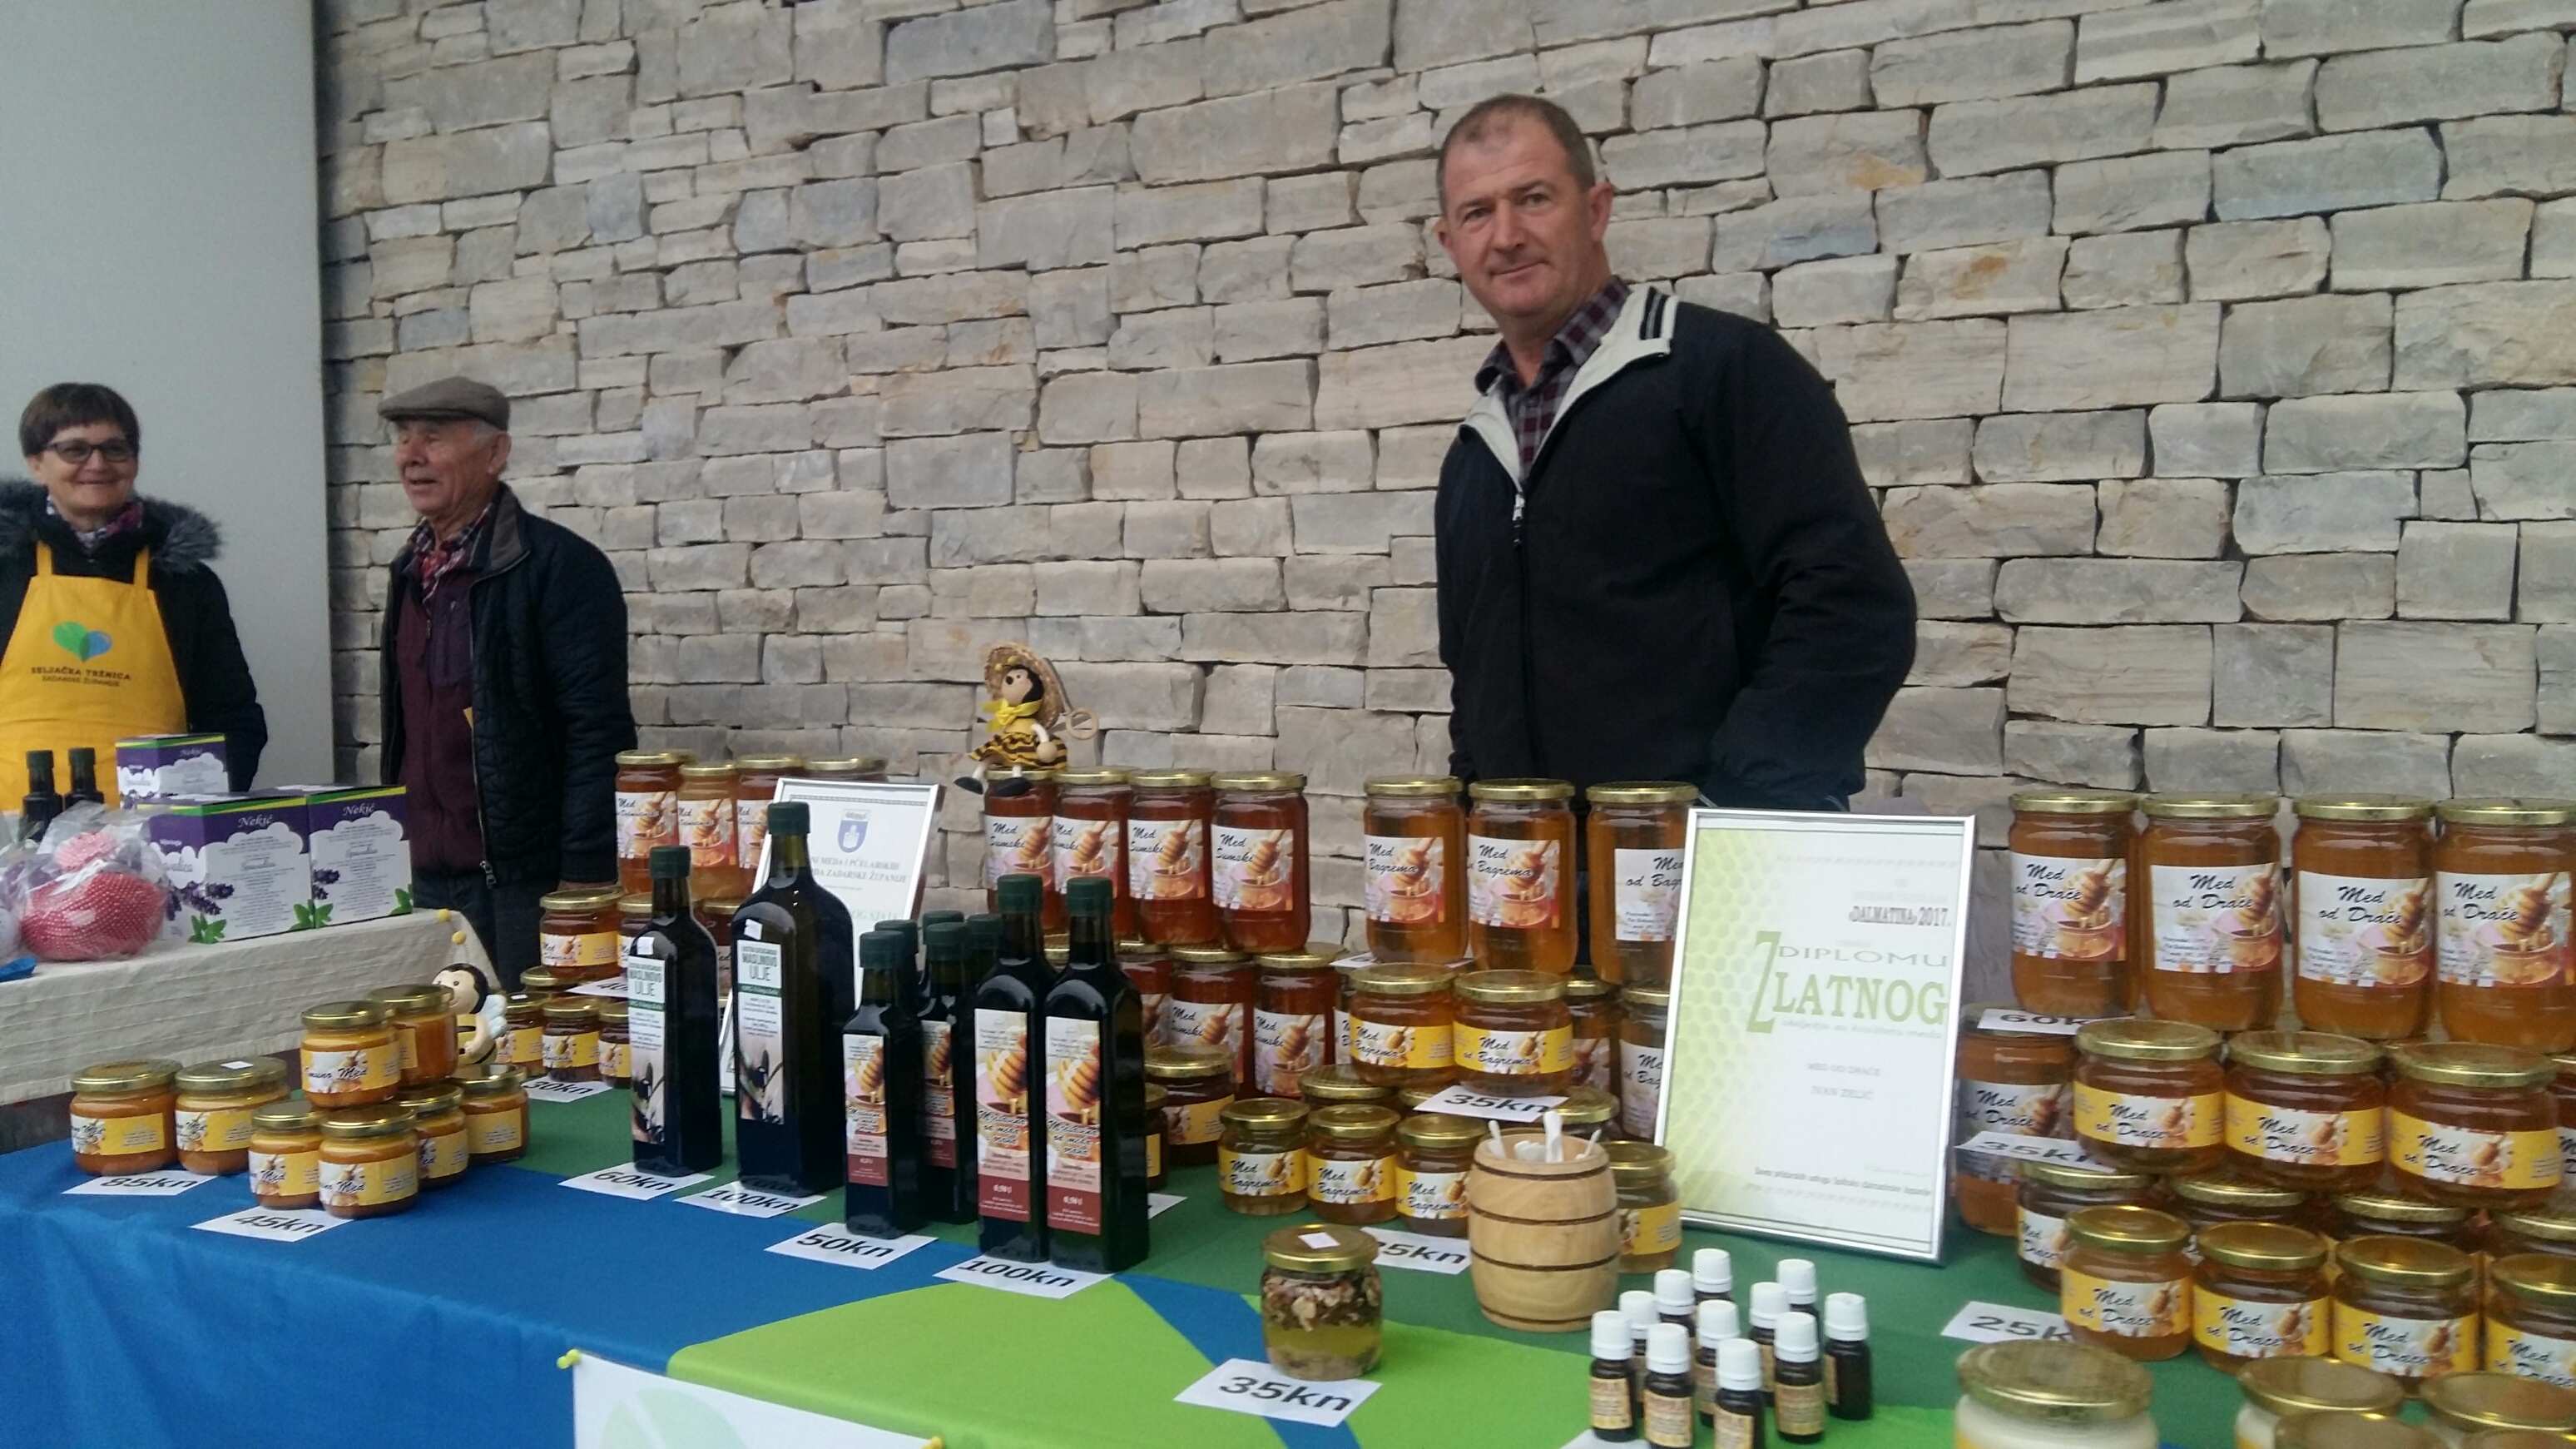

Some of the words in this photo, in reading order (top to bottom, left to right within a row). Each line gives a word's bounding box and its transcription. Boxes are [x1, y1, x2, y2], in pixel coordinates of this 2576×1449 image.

[343, 802, 375, 816] Nekić
[238, 813, 274, 828] Nekić
[993, 823, 1018, 834] Med
[1133, 826, 1156, 839] Med
[1220, 834, 1247, 847] Med
[1370, 843, 1394, 856] Med
[1479, 844, 1508, 859] Med
[1368, 861, 1417, 876] Bagrema
[1476, 861, 1533, 877] Bagrema
[2026, 863, 2066, 881] Med
[1626, 876, 1643, 887] od
[2015, 883, 2028, 895] od
[2189, 874, 2237, 890] Med
[2337, 886, 2386, 904] Med
[2454, 882, 2498, 900] Med
[2172, 896, 2193, 908] od
[2319, 906, 2341, 921] od
[1778, 945, 1948, 967] DIPLOMU
[1173, 1006, 1196, 1021] Med
[1999, 1014, 2089, 1025] 60k
[1256, 1016, 1276, 1031] Med
[1356, 1026, 1380, 1041] Med
[1479, 1035, 1510, 1050] Med
[1477, 1050, 1532, 1067] Bagrema
[1637, 1054, 1662, 1069] Me
[338, 1066, 369, 1079] Med
[523, 1081, 594, 1095] 30kn
[1444, 1094, 1552, 1114] 35kn
[1977, 1089, 2016, 1108] Med
[2108, 1104, 2147, 1121] Med
[2257, 1116, 2299, 1135] Med
[2418, 1134, 2460, 1155] Med
[1976, 1141, 2102, 1165] 35k
[1230, 1159, 1258, 1174] Med
[1318, 1167, 1346, 1182] Med
[101, 1177, 198, 1188] 85kn
[336, 1181, 365, 1192] Med
[592, 1171, 676, 1191] 60kn
[1408, 1180, 1437, 1196] Med
[701, 1188, 800, 1212] 100kn
[234, 1214, 326, 1234] 45kn
[797, 1233, 894, 1259] 50kn
[957, 1259, 1077, 1288] 100kn
[2093, 1288, 2136, 1307] Med
[2220, 1306, 2261, 1327] Med
[1969, 1316, 2071, 1340] 25k
[2364, 1322, 2408, 1343] Med
[2507, 1338, 2553, 1363] Med
[1219, 1376, 1352, 1412] 35kn
